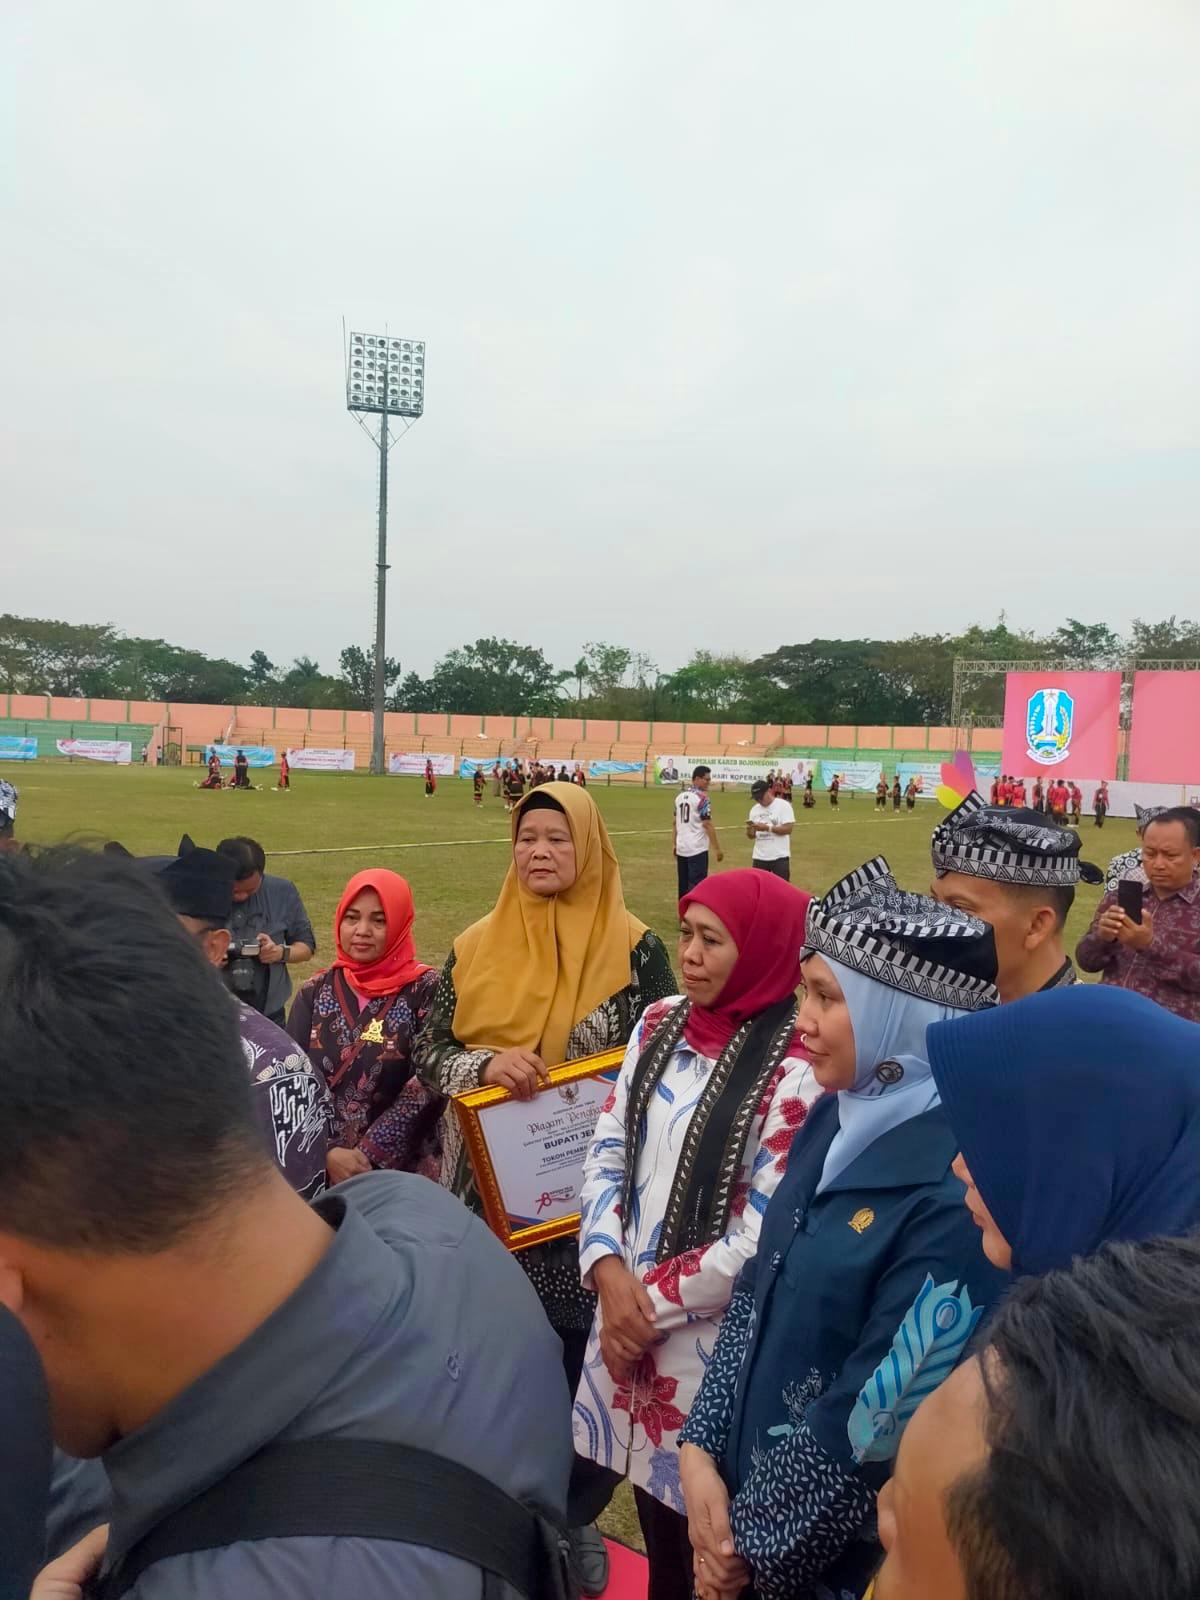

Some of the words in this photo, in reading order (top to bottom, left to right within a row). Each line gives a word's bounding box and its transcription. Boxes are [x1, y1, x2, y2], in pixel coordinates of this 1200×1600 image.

[679, 802, 690, 824] 10
[527, 1118, 564, 1136] Piagam
[544, 1134, 579, 1149] BUPATI
[542, 1152, 565, 1163] TOKOH
